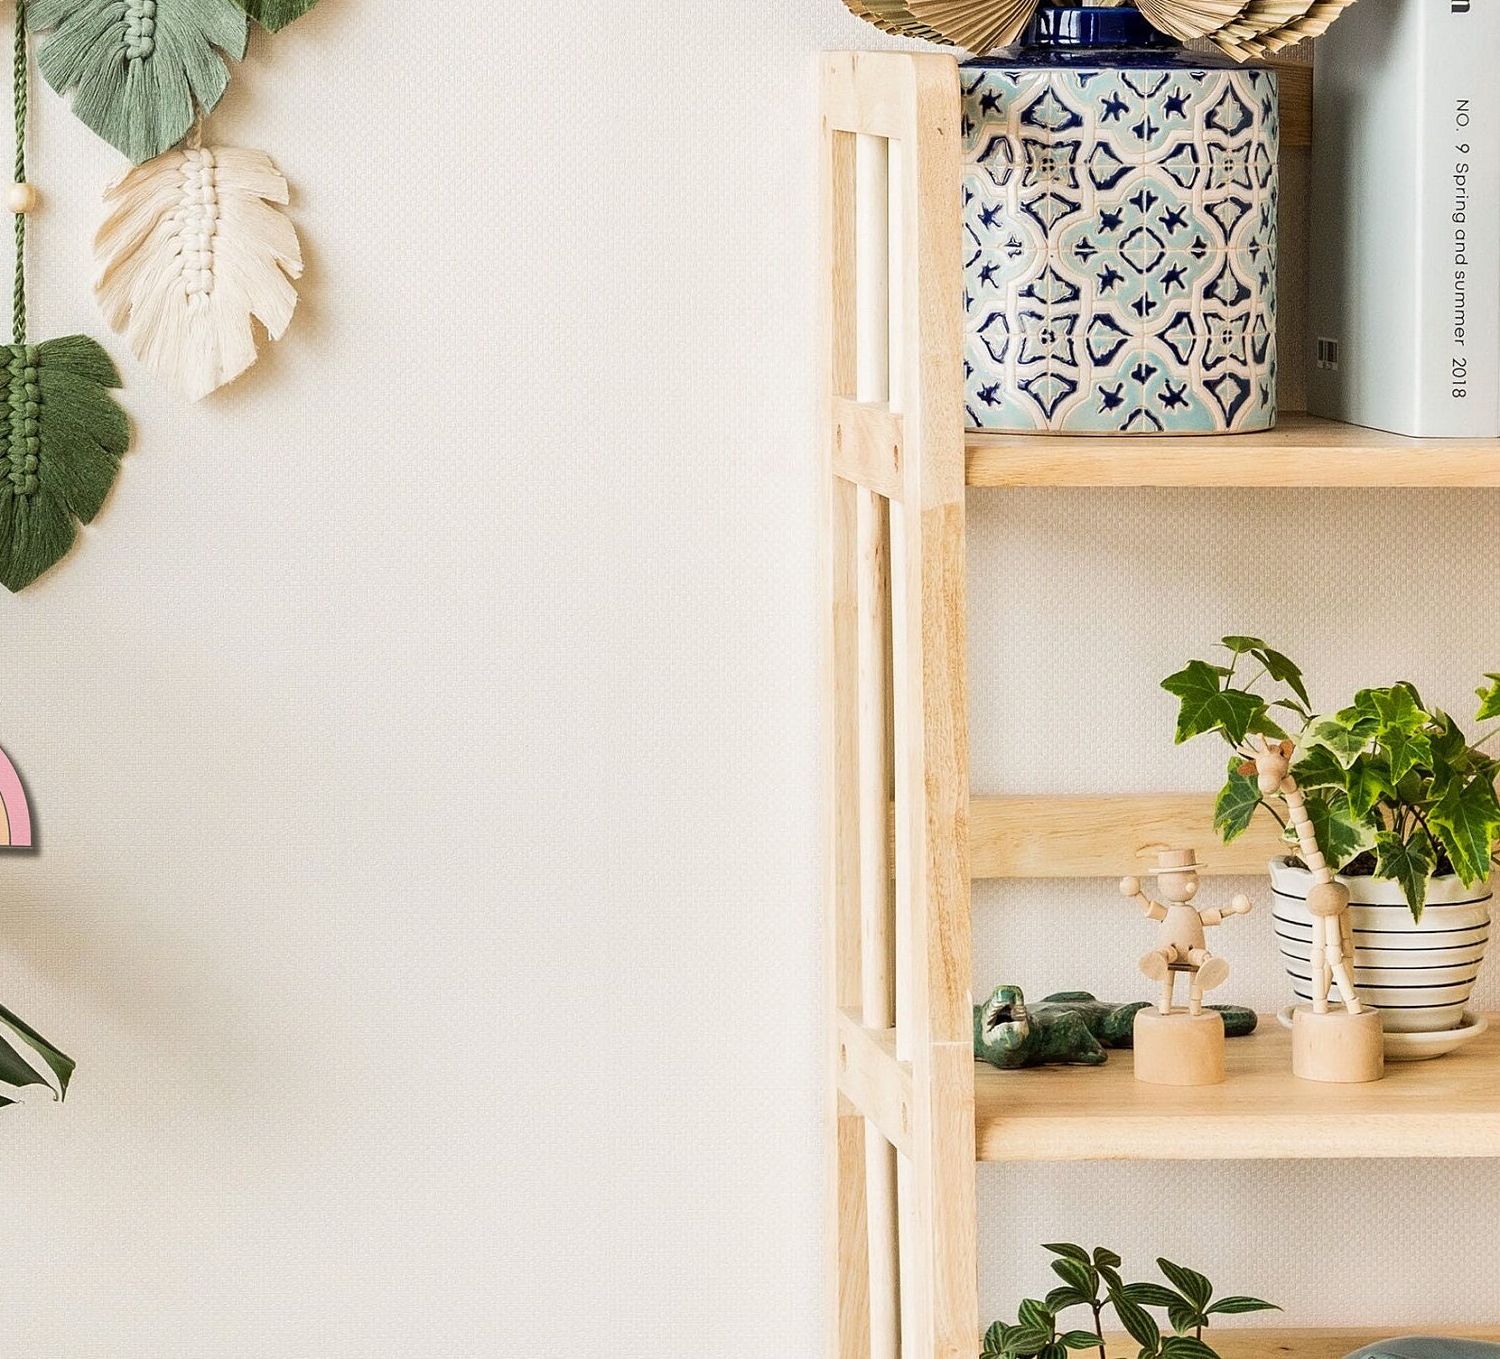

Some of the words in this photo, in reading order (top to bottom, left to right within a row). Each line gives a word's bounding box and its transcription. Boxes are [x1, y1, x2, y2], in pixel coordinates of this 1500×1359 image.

[1456, 99, 1470, 131] NO.
[1455, 143, 1470, 154] 9
[1452, 163, 1469, 223] Spring
[1455, 229, 1468, 265] and
[1454, 270, 1465, 346] summer
[1452, 358, 1467, 398] 2018
